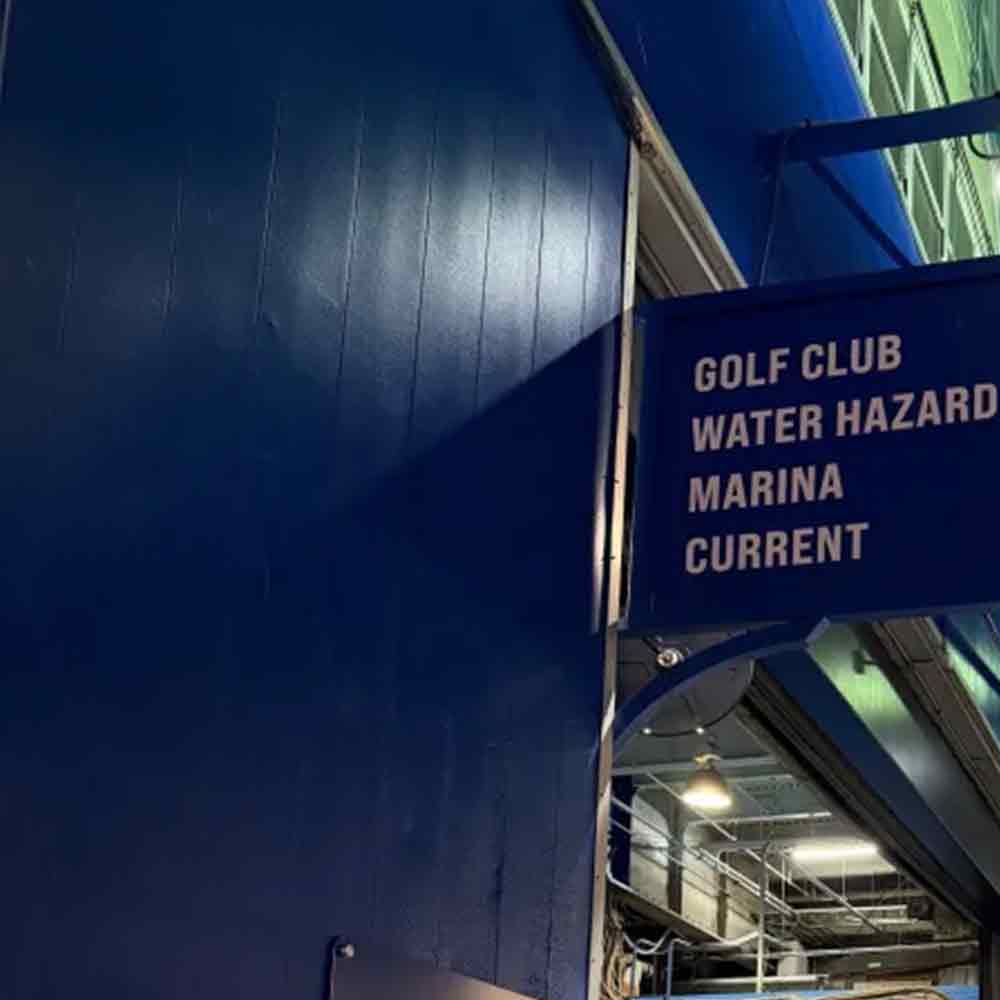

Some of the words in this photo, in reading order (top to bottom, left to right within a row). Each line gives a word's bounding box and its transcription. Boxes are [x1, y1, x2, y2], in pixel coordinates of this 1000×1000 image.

[695, 347, 790, 392] GOLF
[801, 334, 902, 380] CLUB
[692, 400, 823, 452] WATER
[836, 383, 999, 437] HAZARD
[688, 462, 844, 512] MARINA
[685, 522, 870, 574] CURRENT
